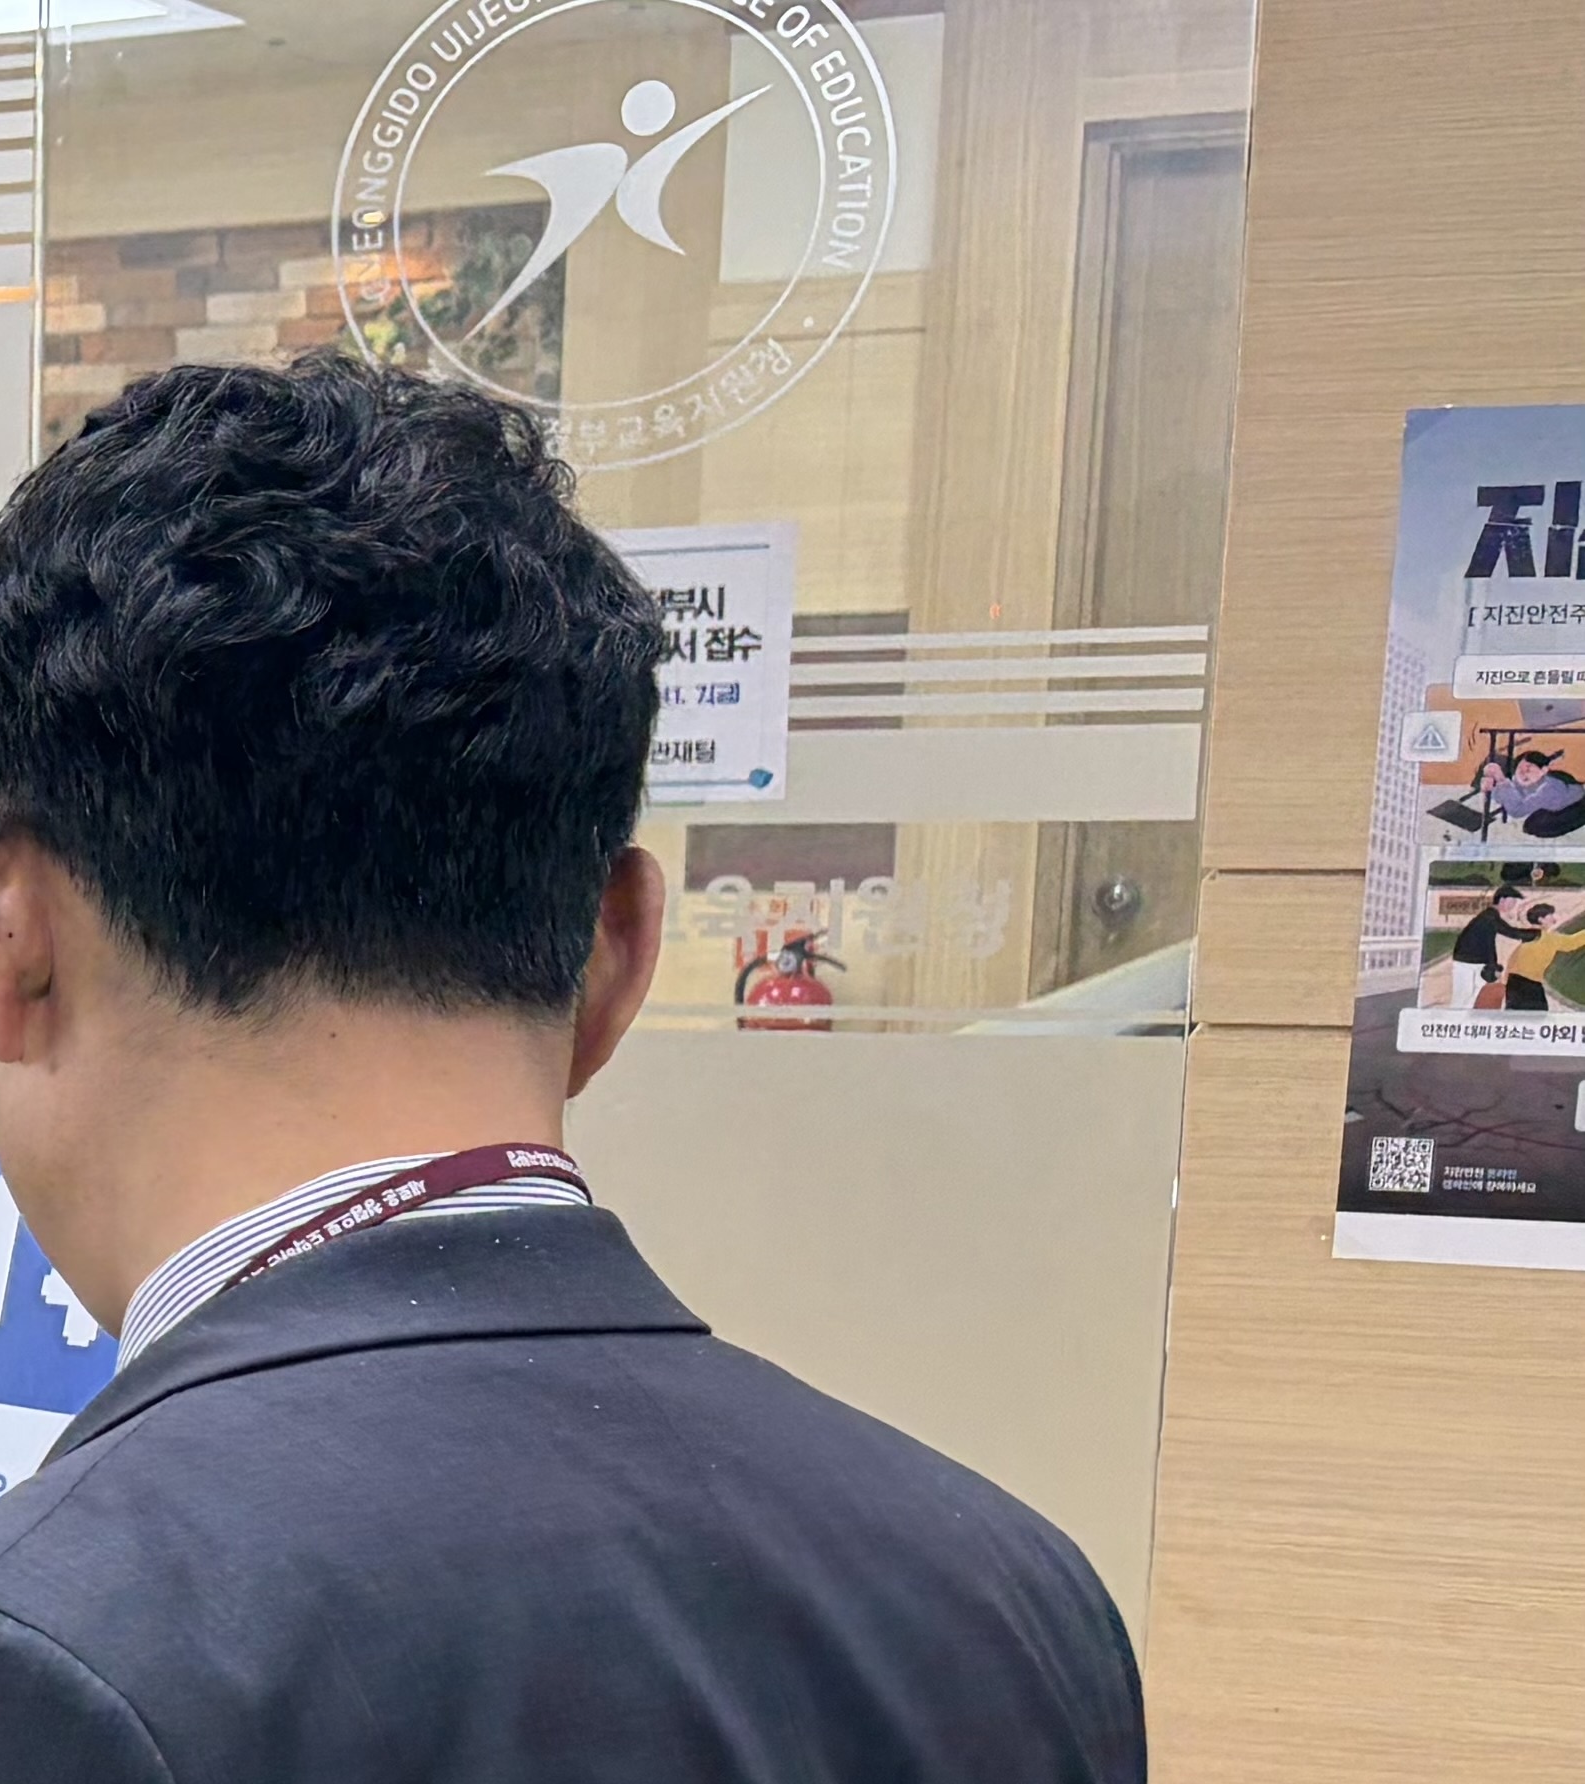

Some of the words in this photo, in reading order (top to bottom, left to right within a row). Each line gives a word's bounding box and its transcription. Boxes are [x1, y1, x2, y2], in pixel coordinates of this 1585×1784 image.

[776, 5, 829, 48] OF
[807, 50, 872, 269] EDUCATION
[1463, 480, 1585, 580] 지
[658, 584, 726, 622] 부시
[704, 625, 762, 663] 접수
[1476, 670, 1531, 685] 지진으로
[1421, 1023, 1461, 1039] 안전한
[1539, 1025, 1577, 1043] 야외
